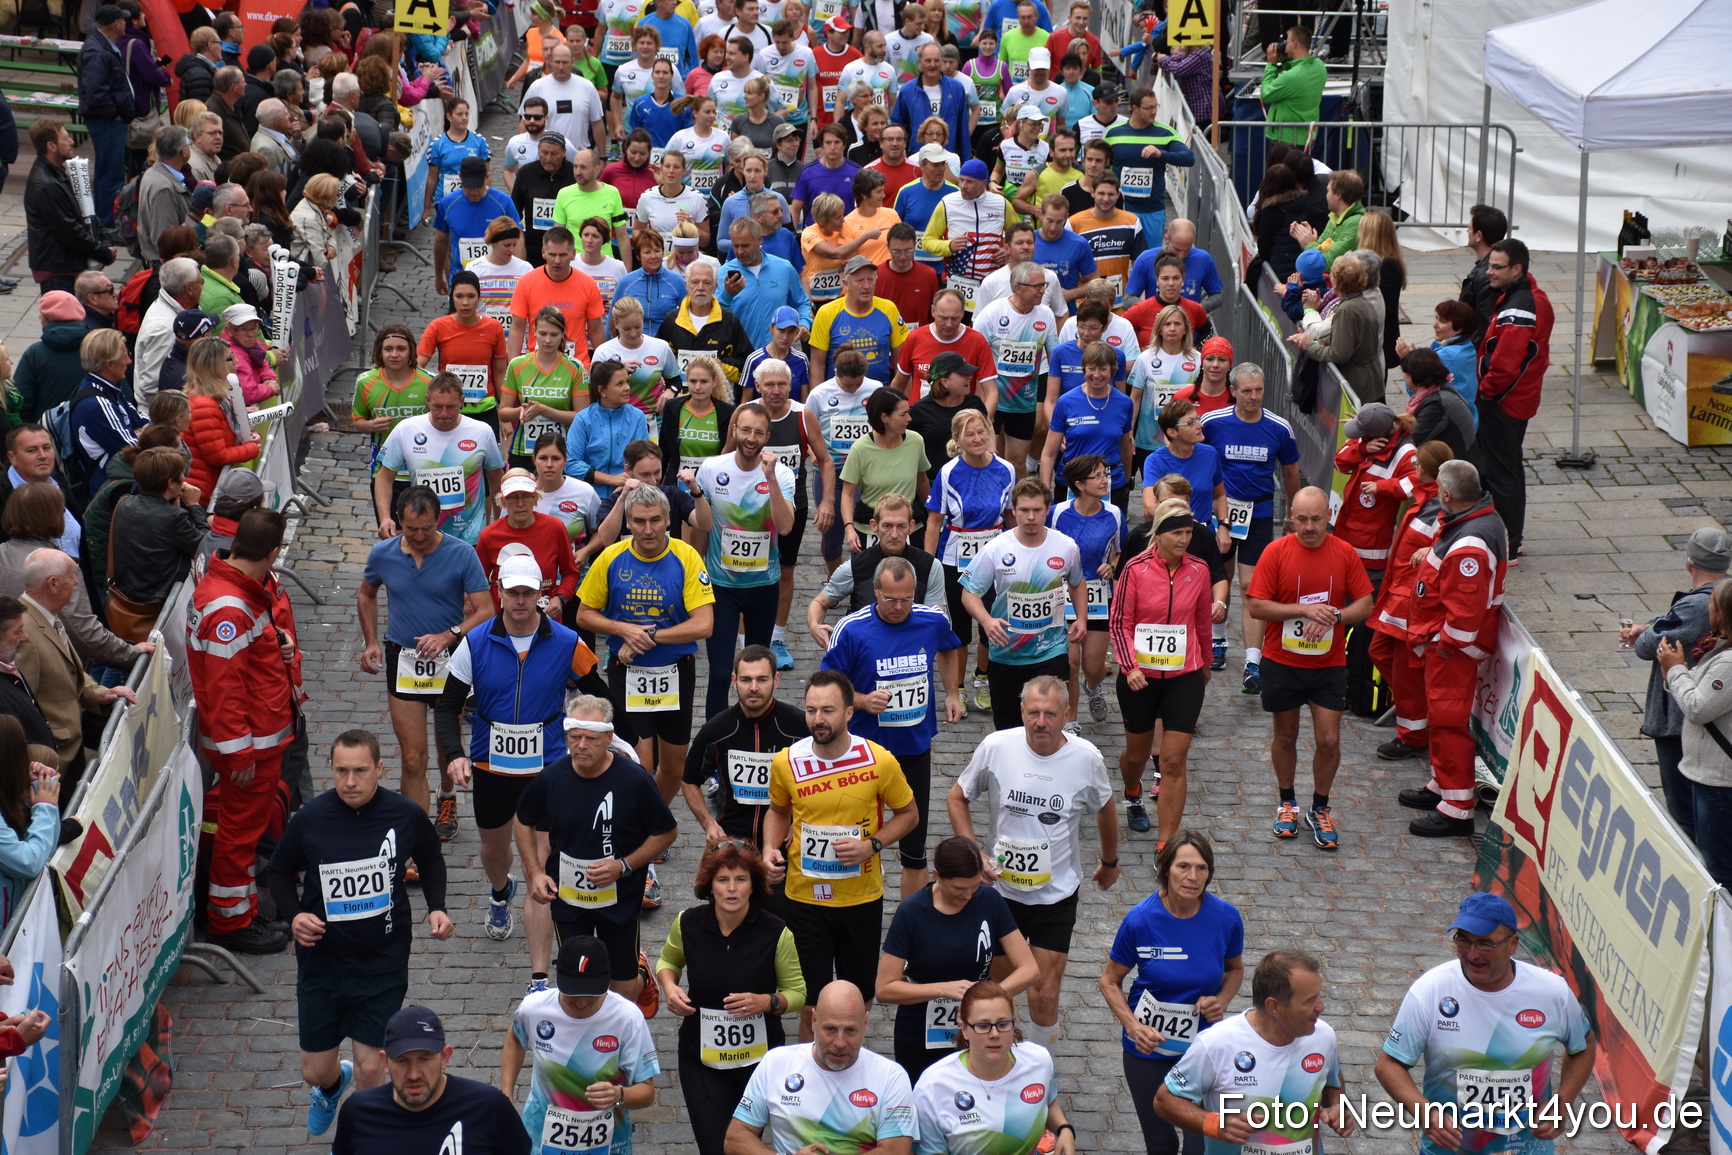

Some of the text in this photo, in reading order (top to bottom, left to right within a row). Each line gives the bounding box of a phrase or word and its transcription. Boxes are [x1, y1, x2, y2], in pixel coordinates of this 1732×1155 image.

[823, 4, 834, 14] 30
[1179, 0, 1208, 27] A
[247, 11, 292, 22] www.dkm
[609, 41, 630, 51] 2628
[1123, 174, 1150, 186] 2253
[1093, 239, 1126, 249] Fischer
[467, 246, 489, 258] 158
[813, 275, 841, 289] 2322
[272, 268, 285, 341] BMW Laufsport
[1003, 349, 1033, 364] 2544
[522, 386, 569, 398] BOCK
[374, 406, 425, 418] BOCK
[678, 428, 719, 440] BOCK
[834, 424, 869, 439] 2339
[460, 441, 475, 449] Hervis
[1225, 445, 1269, 456] HUBER
[1229, 508, 1247, 524] 69
[731, 541, 761, 557] 297
[1049, 559, 1064, 567] Hervis
[1012, 601, 1051, 618] 2636
[1021, 621, 1042, 629] Tobias
[1146, 636, 1177, 653] 178
[1298, 641, 1318, 650] Mario
[876, 654, 928, 670] HUBER
[1150, 657, 1169, 666] Birgit
[414, 660, 436, 677] 60
[888, 666, 926, 675] TECHNOLOGY
[414, 680, 434, 688] Klaus
[637, 676, 669, 694] 315
[878, 679, 922, 690] PARTL Neumarkt
[644, 697, 661, 706] Mark
[890, 711, 921, 721] Christian
[494, 735, 538, 755] 3001
[730, 754, 748, 762] PARTL
[733, 764, 768, 784] 278
[797, 770, 879, 798] MAX BÖGL
[739, 788, 769, 798] Christia
[1007, 789, 1047, 808] Allianz
[803, 827, 820, 837] PARTL
[806, 838, 838, 859] 27
[1011, 843, 1039, 851] Neumarkt
[561, 857, 577, 869] PARTL
[1004, 850, 1039, 872] 232
[321, 863, 377, 876] PARTL Neumarkt
[329, 871, 384, 899] 2020
[1011, 875, 1033, 887] Georg
[575, 893, 598, 902] Janke
[343, 900, 374, 912] Florian
[1142, 994, 1190, 1016] PARTL Neumarkt
[702, 1014, 756, 1023] PARTL Neumarkt
[1138, 1007, 1193, 1039] 3042
[1520, 1014, 1543, 1024] Hervis
[713, 1023, 755, 1047] 369
[535, 1040, 553, 1050] PARTL
[535, 1045, 554, 1054] Neumarkt
[596, 1040, 617, 1048] Hervis
[719, 1051, 750, 1062] Marion
[1305, 1058, 1324, 1068] Hervis
[1459, 1073, 1484, 1082] PARTL
[781, 1095, 801, 1103] PARTL
[853, 1093, 875, 1103] Hervis
[1023, 1087, 1044, 1099] Hervis
[1465, 1085, 1526, 1110] 2453
[547, 1110, 603, 1124] PARTL Neumarkt
[959, 1113, 981, 1122] PARTL
[960, 1118, 982, 1126] Neumarkt
[549, 1122, 608, 1147] 2543
[1243, 1146, 1268, 1155] PARTL
